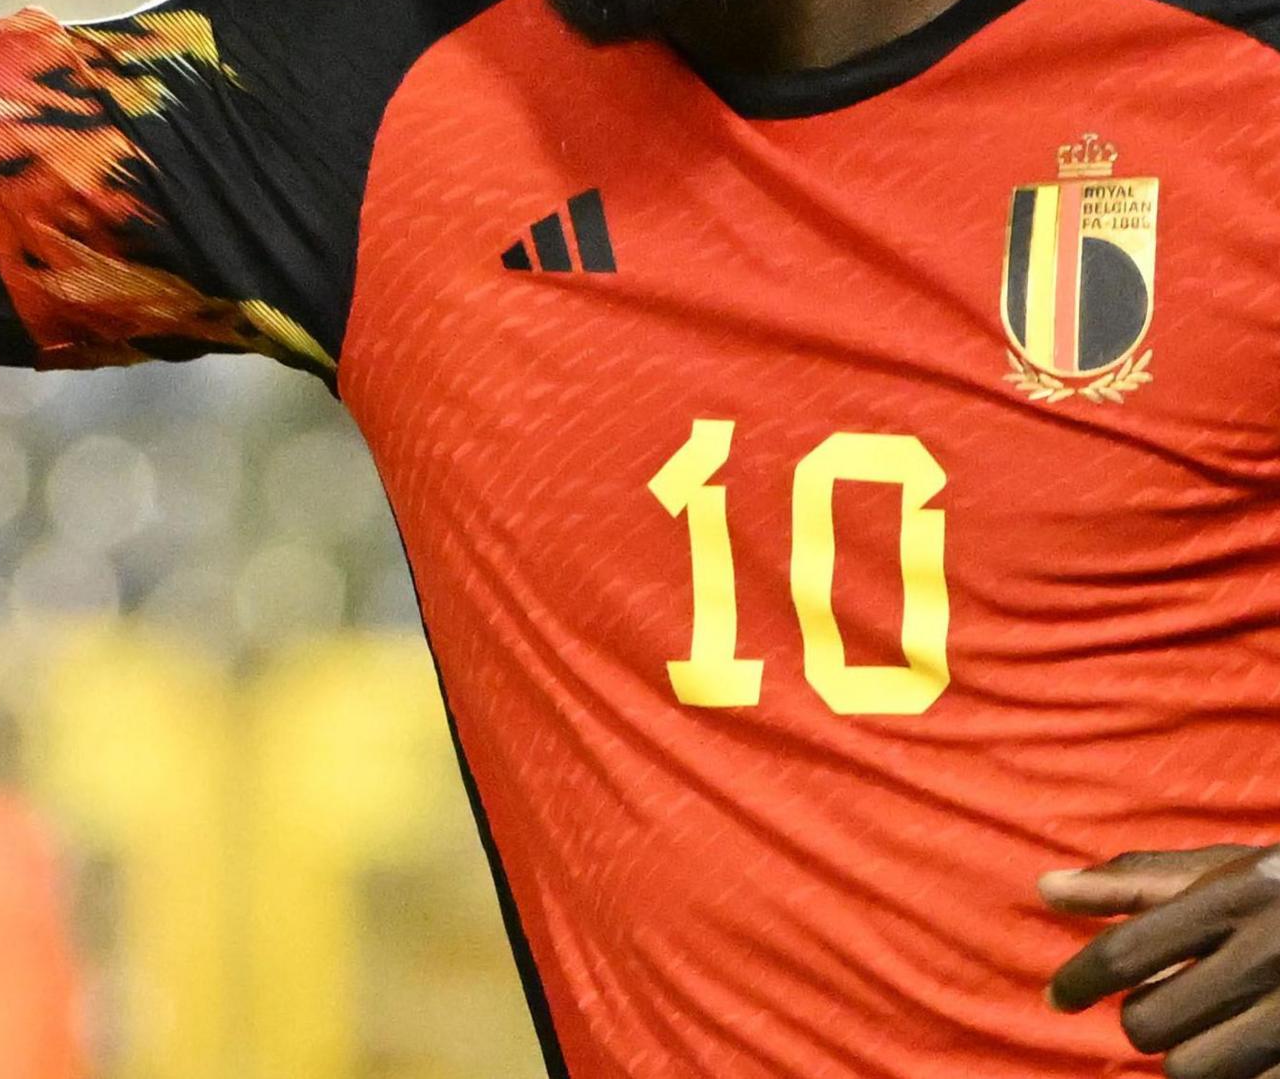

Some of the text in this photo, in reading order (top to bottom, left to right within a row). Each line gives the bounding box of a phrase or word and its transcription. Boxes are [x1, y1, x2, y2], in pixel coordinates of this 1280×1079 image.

[1084, 185, 1134, 199] ROYAL
[1083, 201, 1152, 215] BELGIAN
[647, 419, 951, 715] 10
